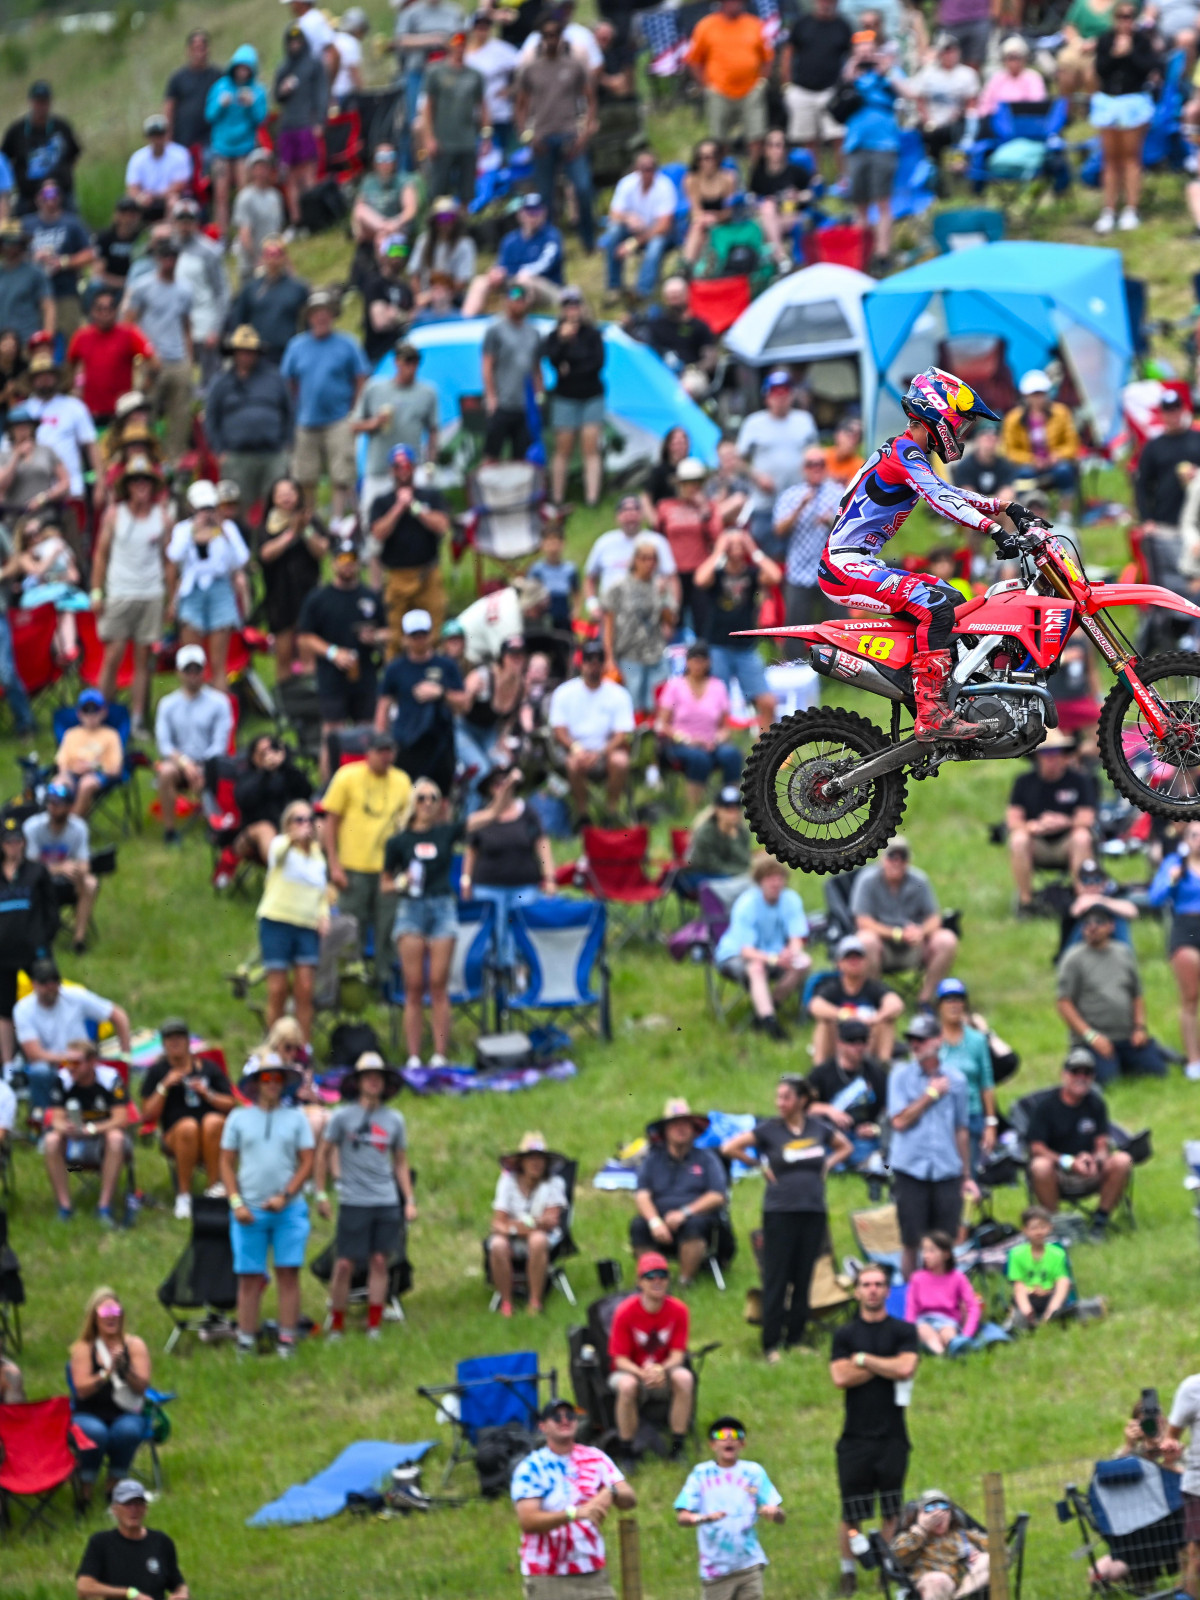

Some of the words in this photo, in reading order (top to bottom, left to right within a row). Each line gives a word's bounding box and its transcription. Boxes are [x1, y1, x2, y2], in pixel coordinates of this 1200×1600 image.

[851, 601, 887, 611] HONDA
[844, 621, 893, 631] HONDA
[968, 623, 1023, 633] PROGRESSIVE
[857, 635, 896, 660] 18
[1091, 627, 1116, 659] SHOWA
